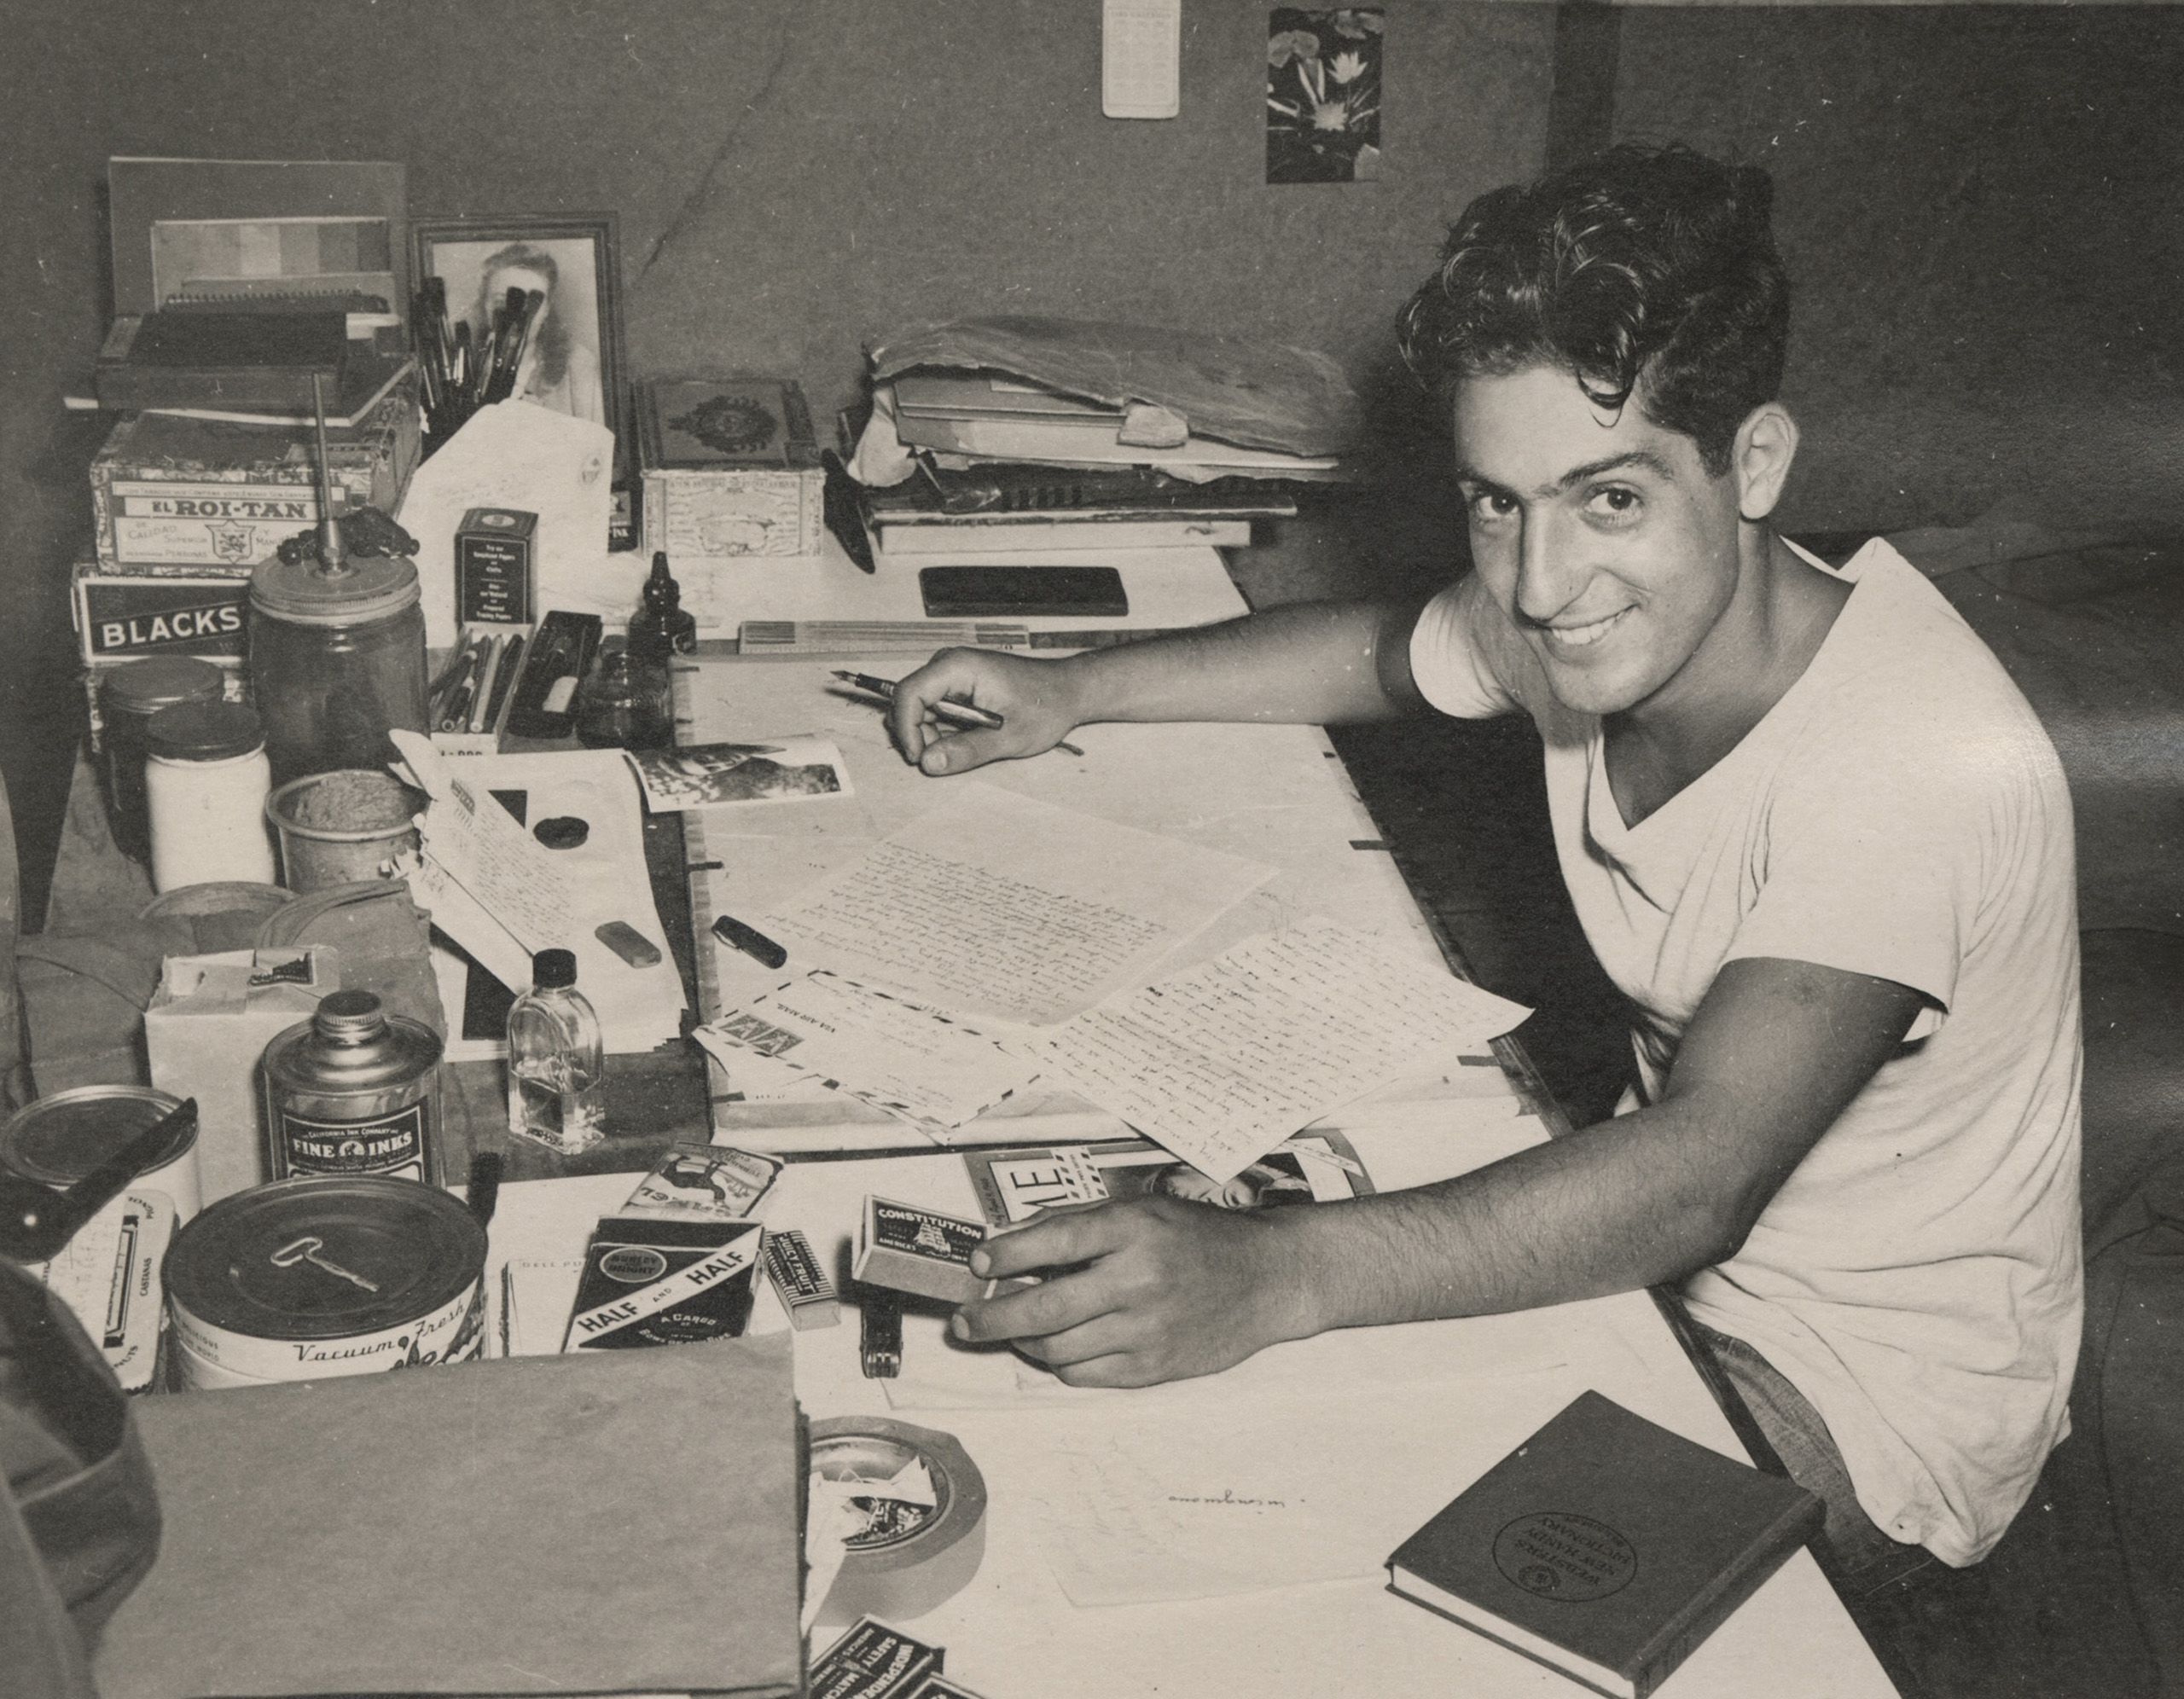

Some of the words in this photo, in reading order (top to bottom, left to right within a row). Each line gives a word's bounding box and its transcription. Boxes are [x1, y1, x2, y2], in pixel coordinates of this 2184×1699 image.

[152, 501, 171, 513] EL
[175, 500, 307, 519] ROI-TAN
[102, 606, 241, 647] BLACKS
[777, 1002, 801, 1016] MAIL
[799, 1014, 819, 1023] AIR
[819, 1022, 835, 1034] VIA
[293, 1138, 335, 1158] FINE
[368, 1131, 413, 1156] INKS
[309, 1130, 346, 1139] CALIFORNIA
[361, 1127, 391, 1137] COMPANY
[878, 1208, 982, 1239] CONSTITUTION
[140, 1257, 153, 1296] CASTANAS
[778, 1235, 800, 1261] JUICY
[793, 1262, 816, 1294] FRUIT
[578, 1302, 638, 1332] HALF
[652, 1287, 672, 1303] AND
[686, 1250, 745, 1285] HALF
[293, 1340, 395, 1362] Vacuum
[414, 1301, 468, 1340] Fresh
[660, 1315, 670, 1324] A
[672, 1313, 717, 1327] CARGO
[1525, 1527, 1579, 1557] HANDY
[1542, 1516, 1632, 1566] DICTIONARY
[1580, 1556, 1615, 1576] NEW
[863, 1636, 897, 1668] SAFETY
